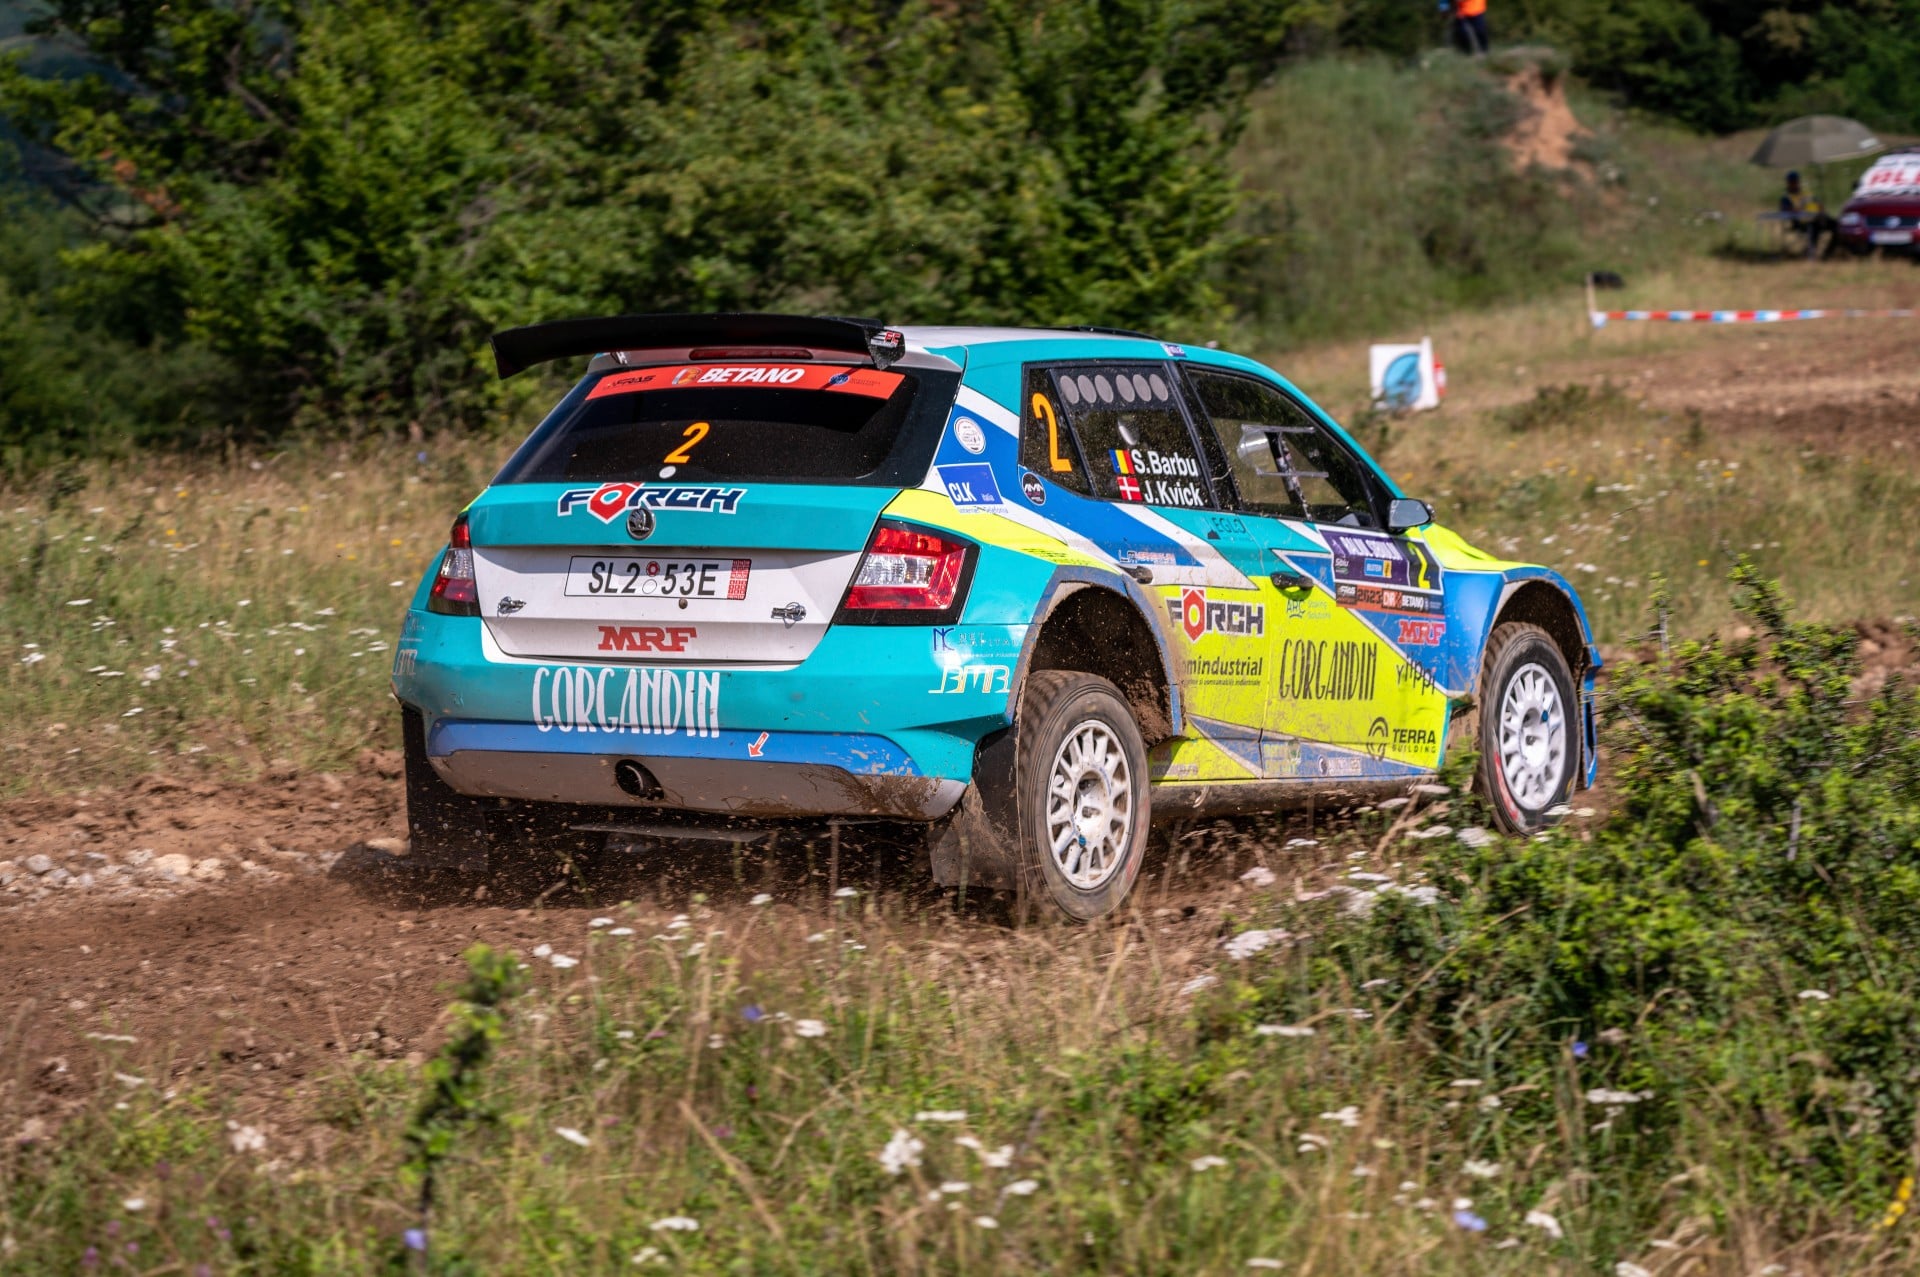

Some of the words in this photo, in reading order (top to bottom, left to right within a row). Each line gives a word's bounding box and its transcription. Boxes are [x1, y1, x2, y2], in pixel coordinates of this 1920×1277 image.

[697, 367, 805, 384] BETANO
[663, 422, 711, 464] 2
[1032, 392, 1073, 472] 2
[948, 482, 977, 502] CLK
[1407, 541, 1431, 590] 2
[598, 626, 698, 652] MRF
[1397, 619, 1446, 646] MRF
[1392, 728, 1437, 744] TERRA
